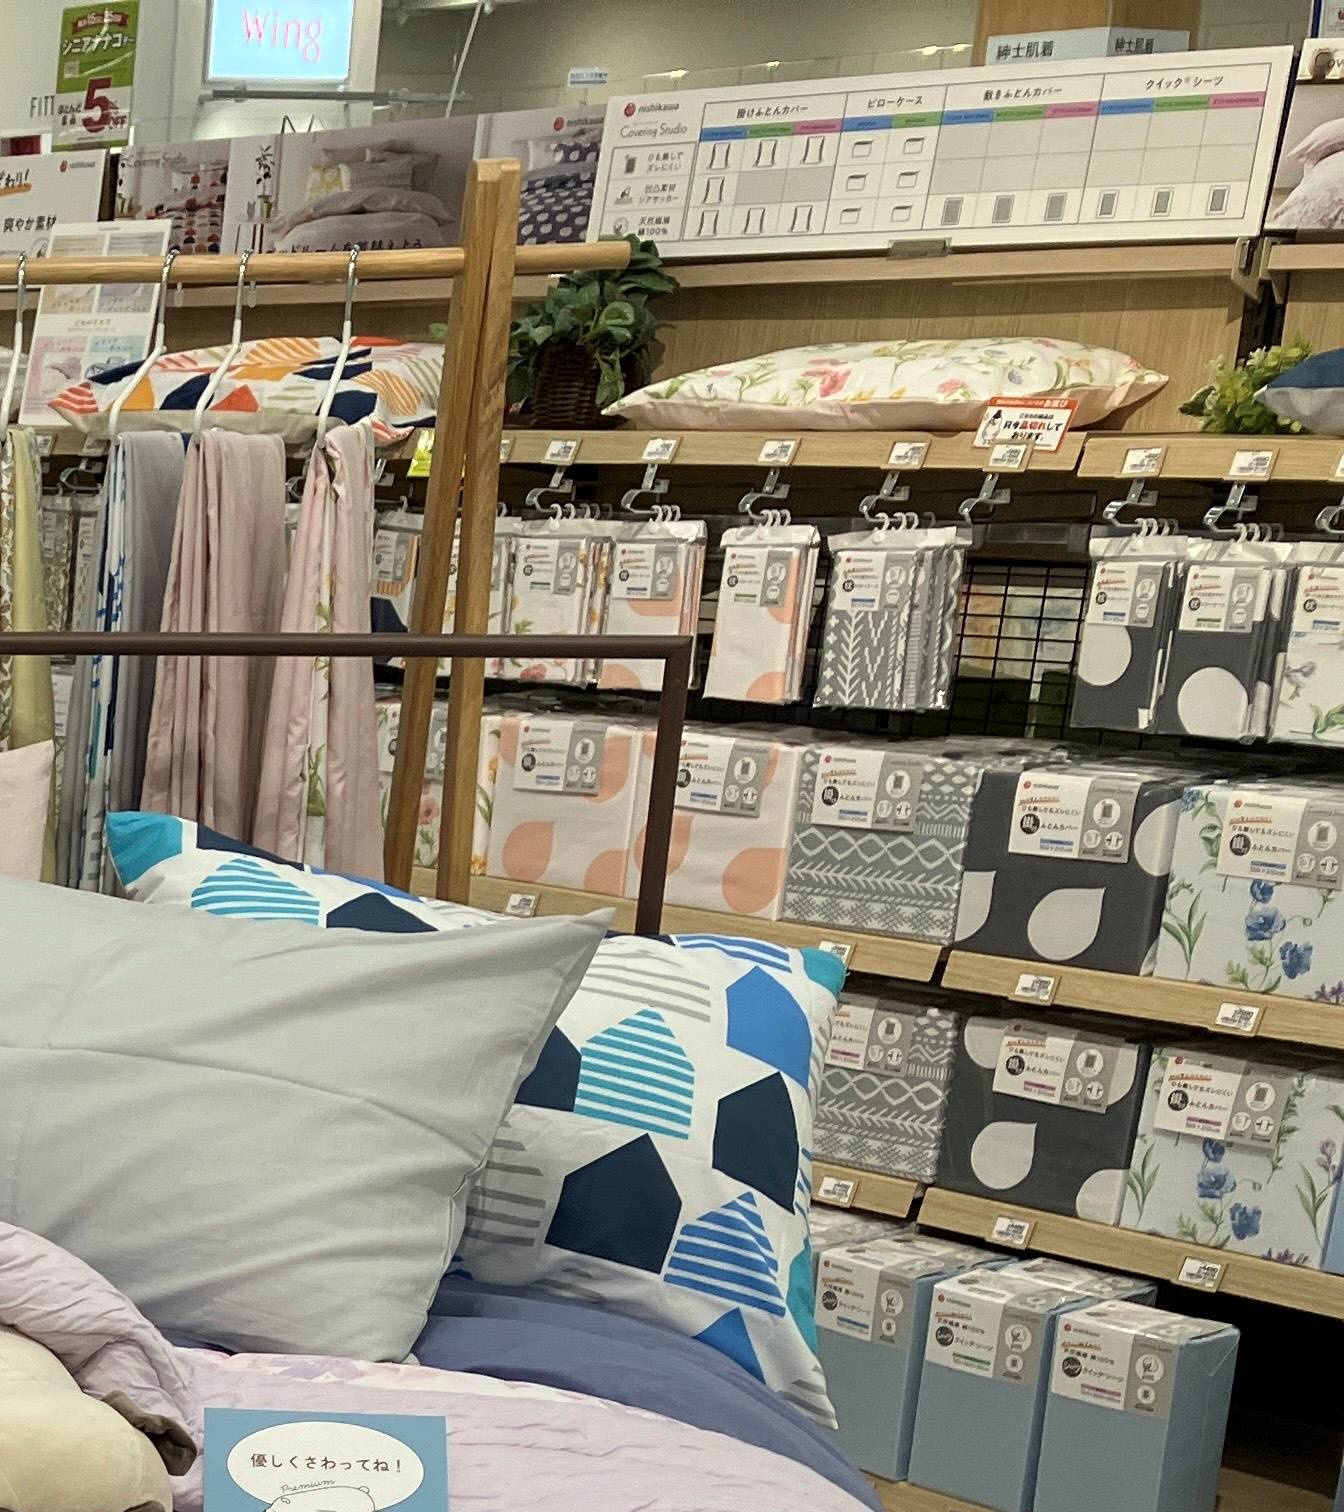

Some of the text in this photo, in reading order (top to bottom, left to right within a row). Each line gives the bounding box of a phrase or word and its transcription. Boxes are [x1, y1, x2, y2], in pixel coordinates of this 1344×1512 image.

[241, 9, 324, 63] Wing
[997, 40, 1053, 60] 紳士肌着
[867, 95, 924, 110] ピローケース
[620, 125, 657, 139] Covering
[659, 122, 688, 137] Studio
[250, 1452, 402, 1474] 優しくさわってね！
[280, 1478, 336, 1493] Premium
